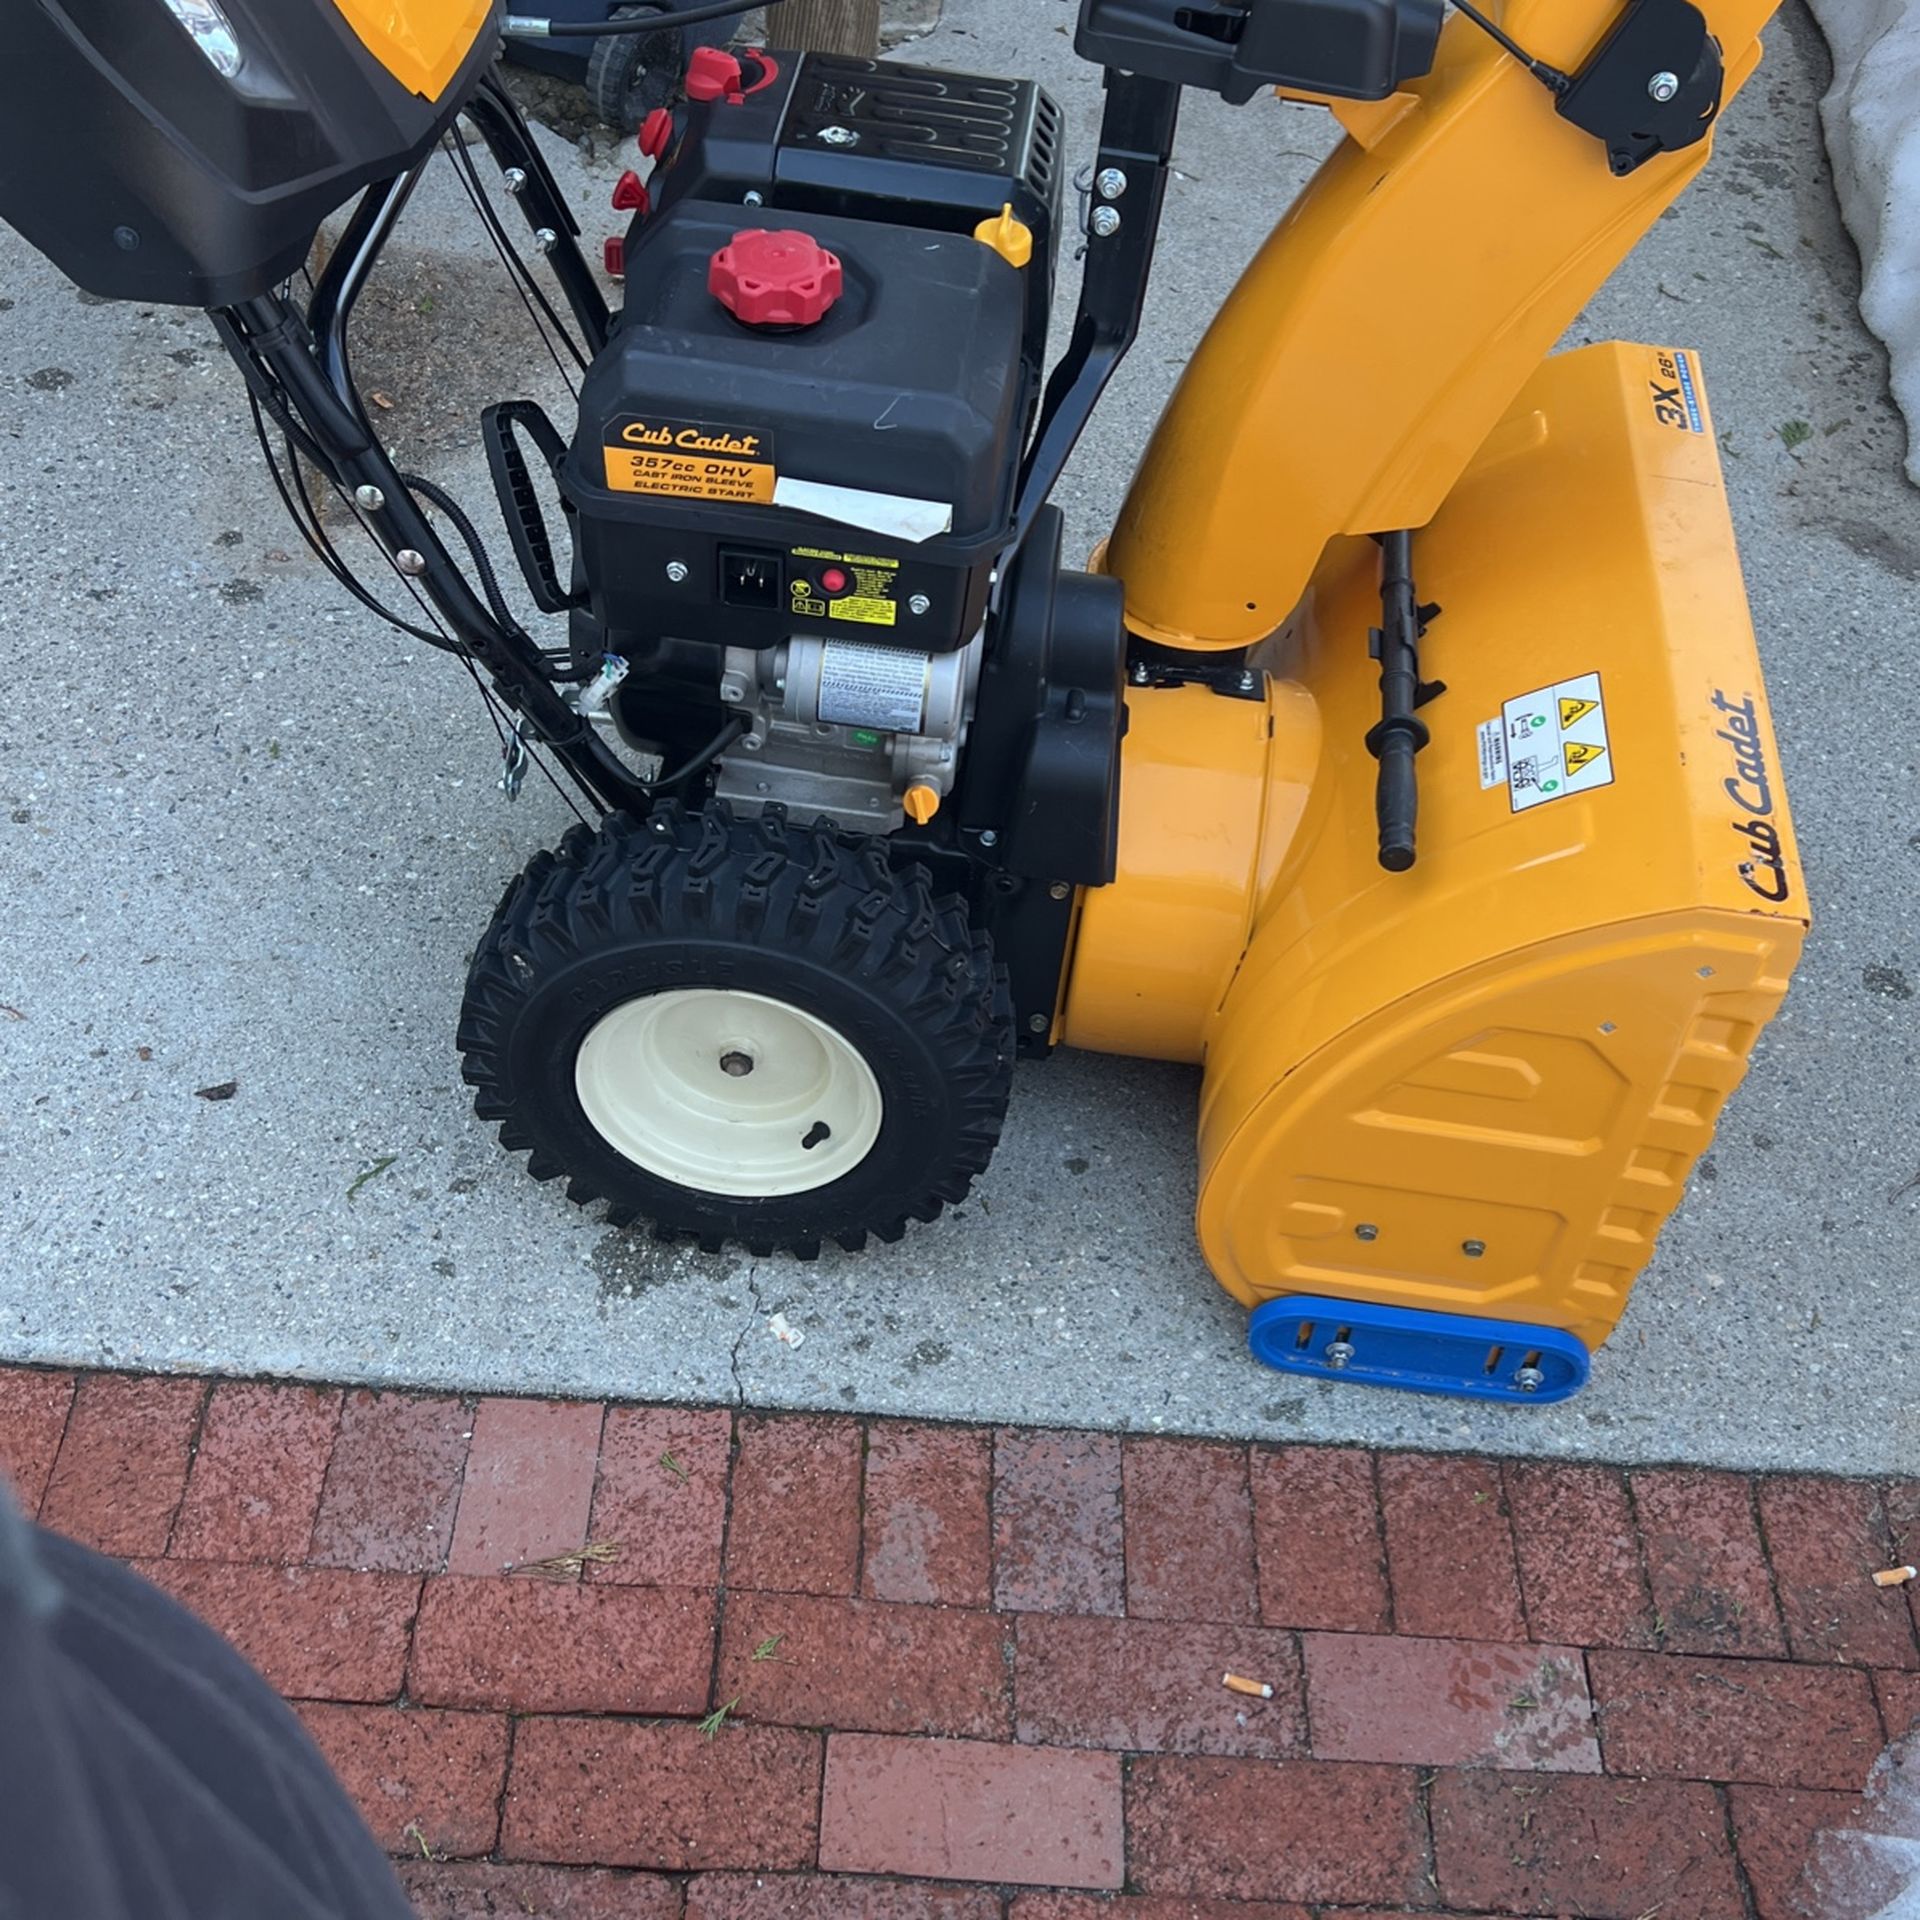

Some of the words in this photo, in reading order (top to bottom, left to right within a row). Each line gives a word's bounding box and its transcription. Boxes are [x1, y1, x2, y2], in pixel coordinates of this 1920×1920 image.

[1649, 380, 1688, 430] 3X
[622, 422, 673, 445] Cub
[675, 429, 760, 455] Cadet
[630, 456, 696, 472] 357cc
[704, 464, 752, 478] OHV
[633, 469, 668, 479] CAST
[671, 474, 702, 483] IRON
[705, 476, 754, 489] SLEEVE
[634, 481, 704, 494] ELECTRIC
[707, 486, 755, 499] START
[1711, 688, 1773, 816] Cadet
[1732, 820, 1789, 903] Cub
